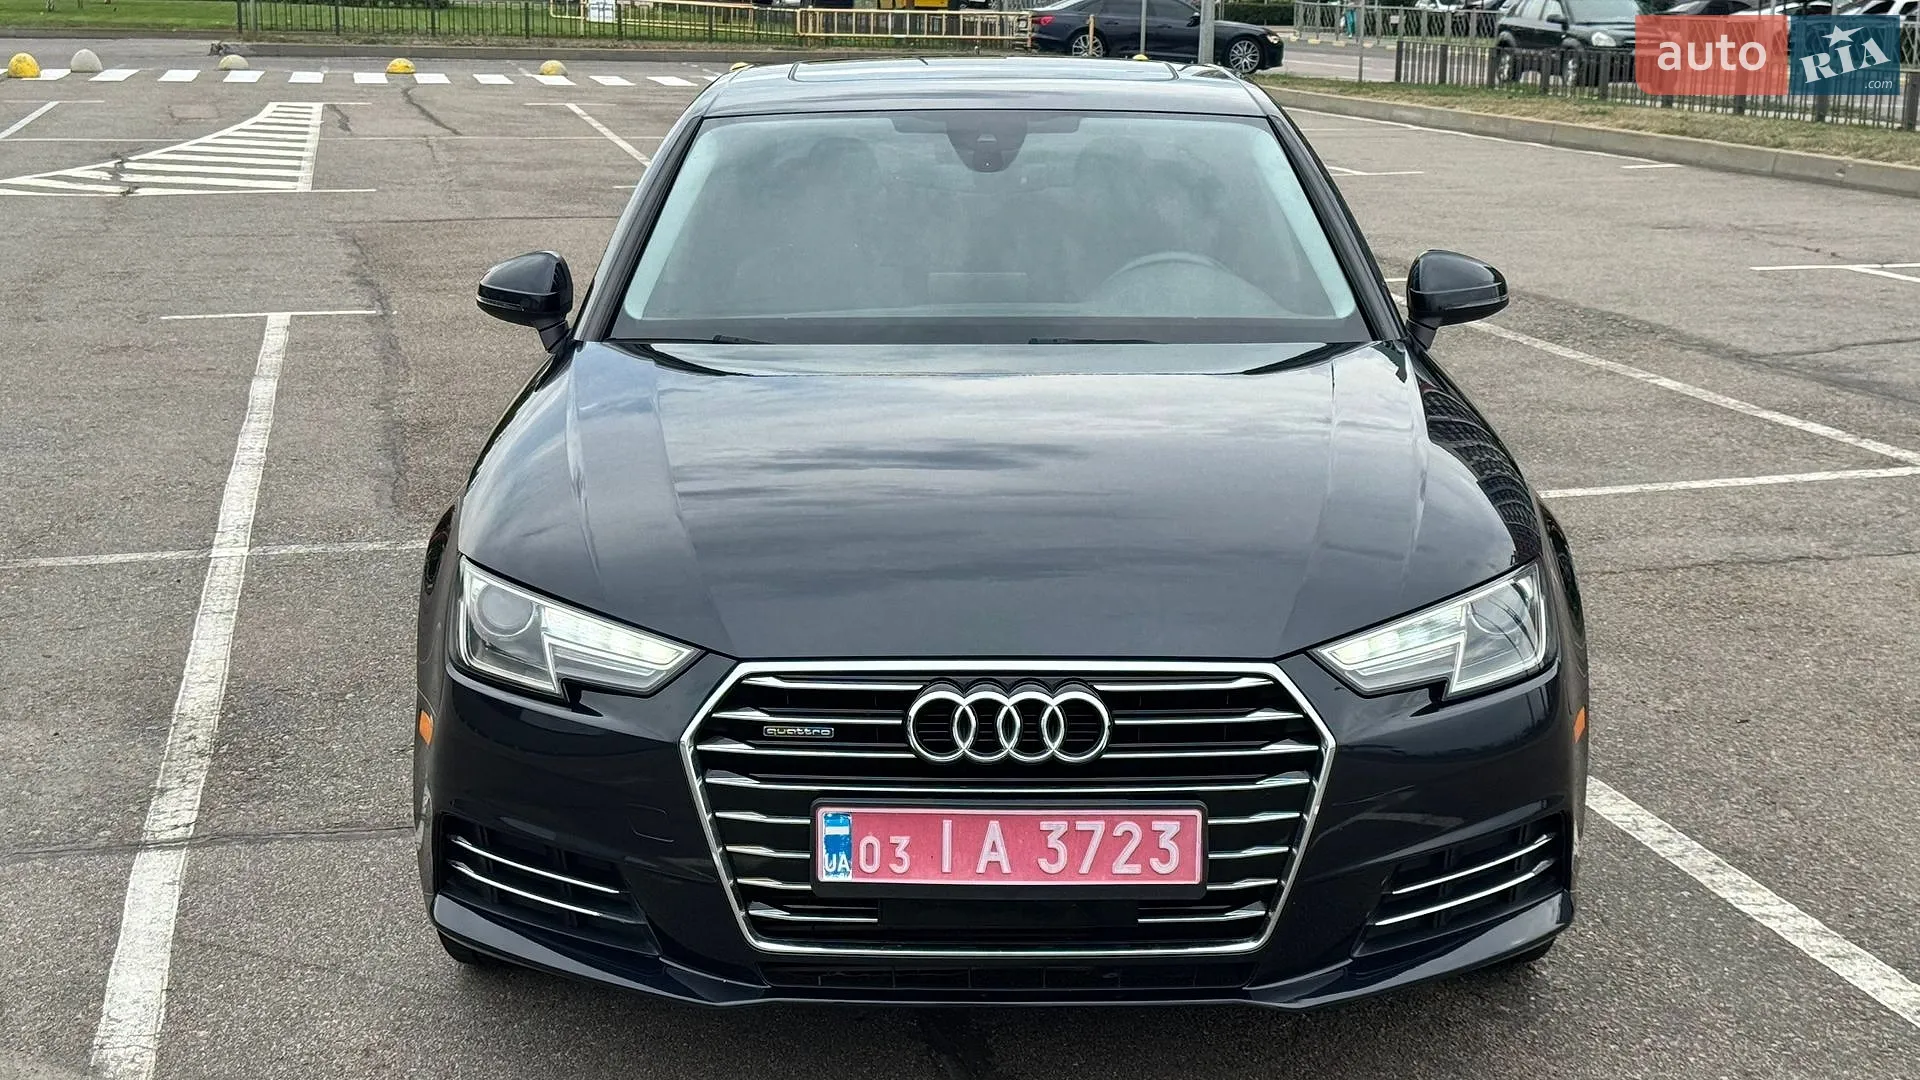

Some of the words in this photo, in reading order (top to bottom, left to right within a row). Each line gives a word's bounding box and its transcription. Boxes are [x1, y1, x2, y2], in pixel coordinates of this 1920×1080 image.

[766, 728, 831, 736] quattro
[859, 835, 911, 874] 03
[1037, 820, 1181, 875] 3723
[824, 852, 851, 872] UA
